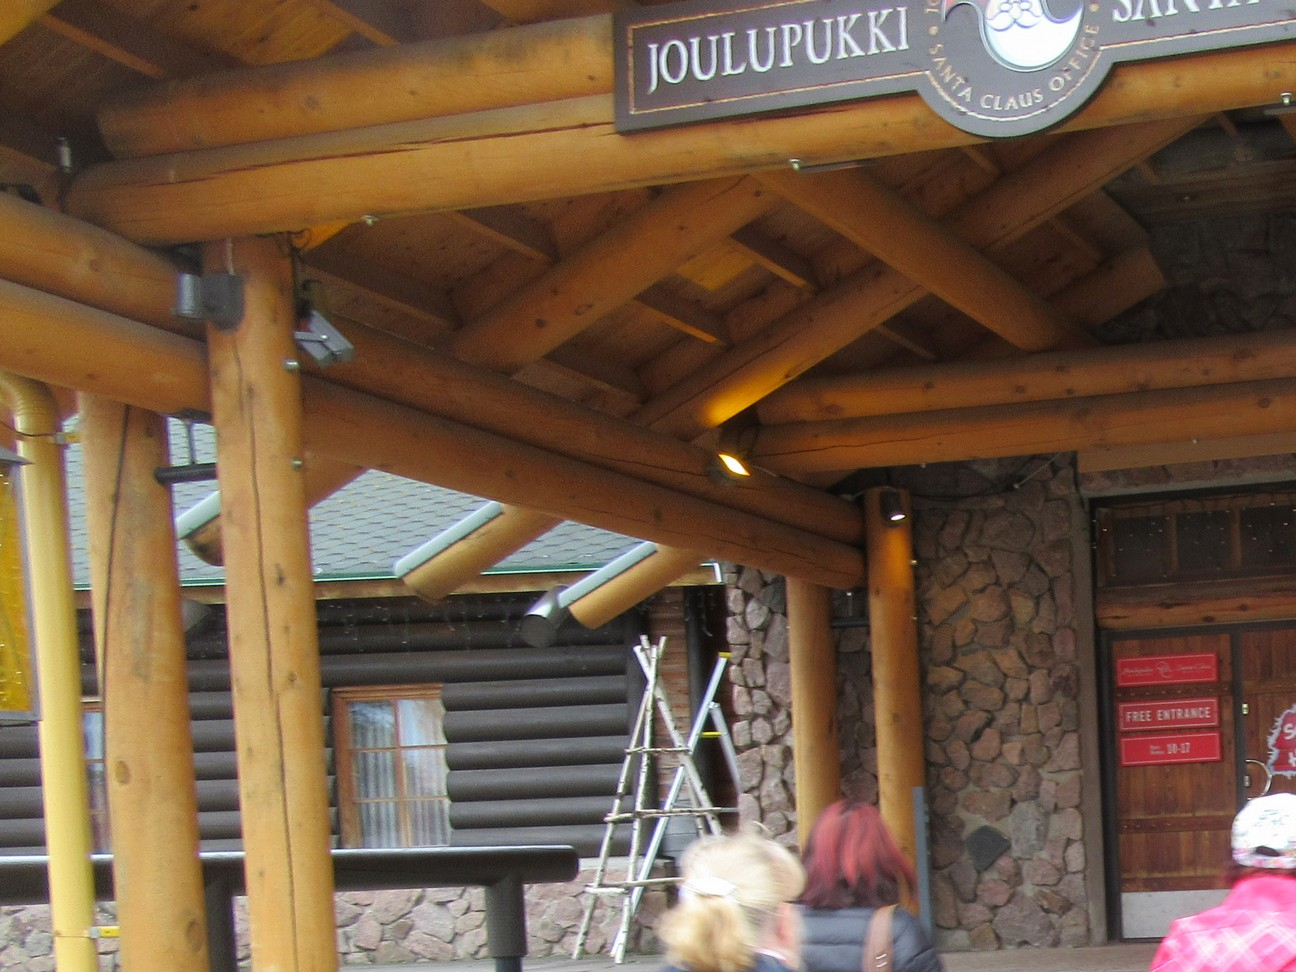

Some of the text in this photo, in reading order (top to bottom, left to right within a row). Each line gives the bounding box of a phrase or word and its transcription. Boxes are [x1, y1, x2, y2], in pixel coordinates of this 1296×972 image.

[648, 7, 910, 94] JOULUPUKKI
[928, 24, 1100, 111] SANTA CLAUS OFFICE
[1125, 706, 1211, 723] FREE ENTRANCE
